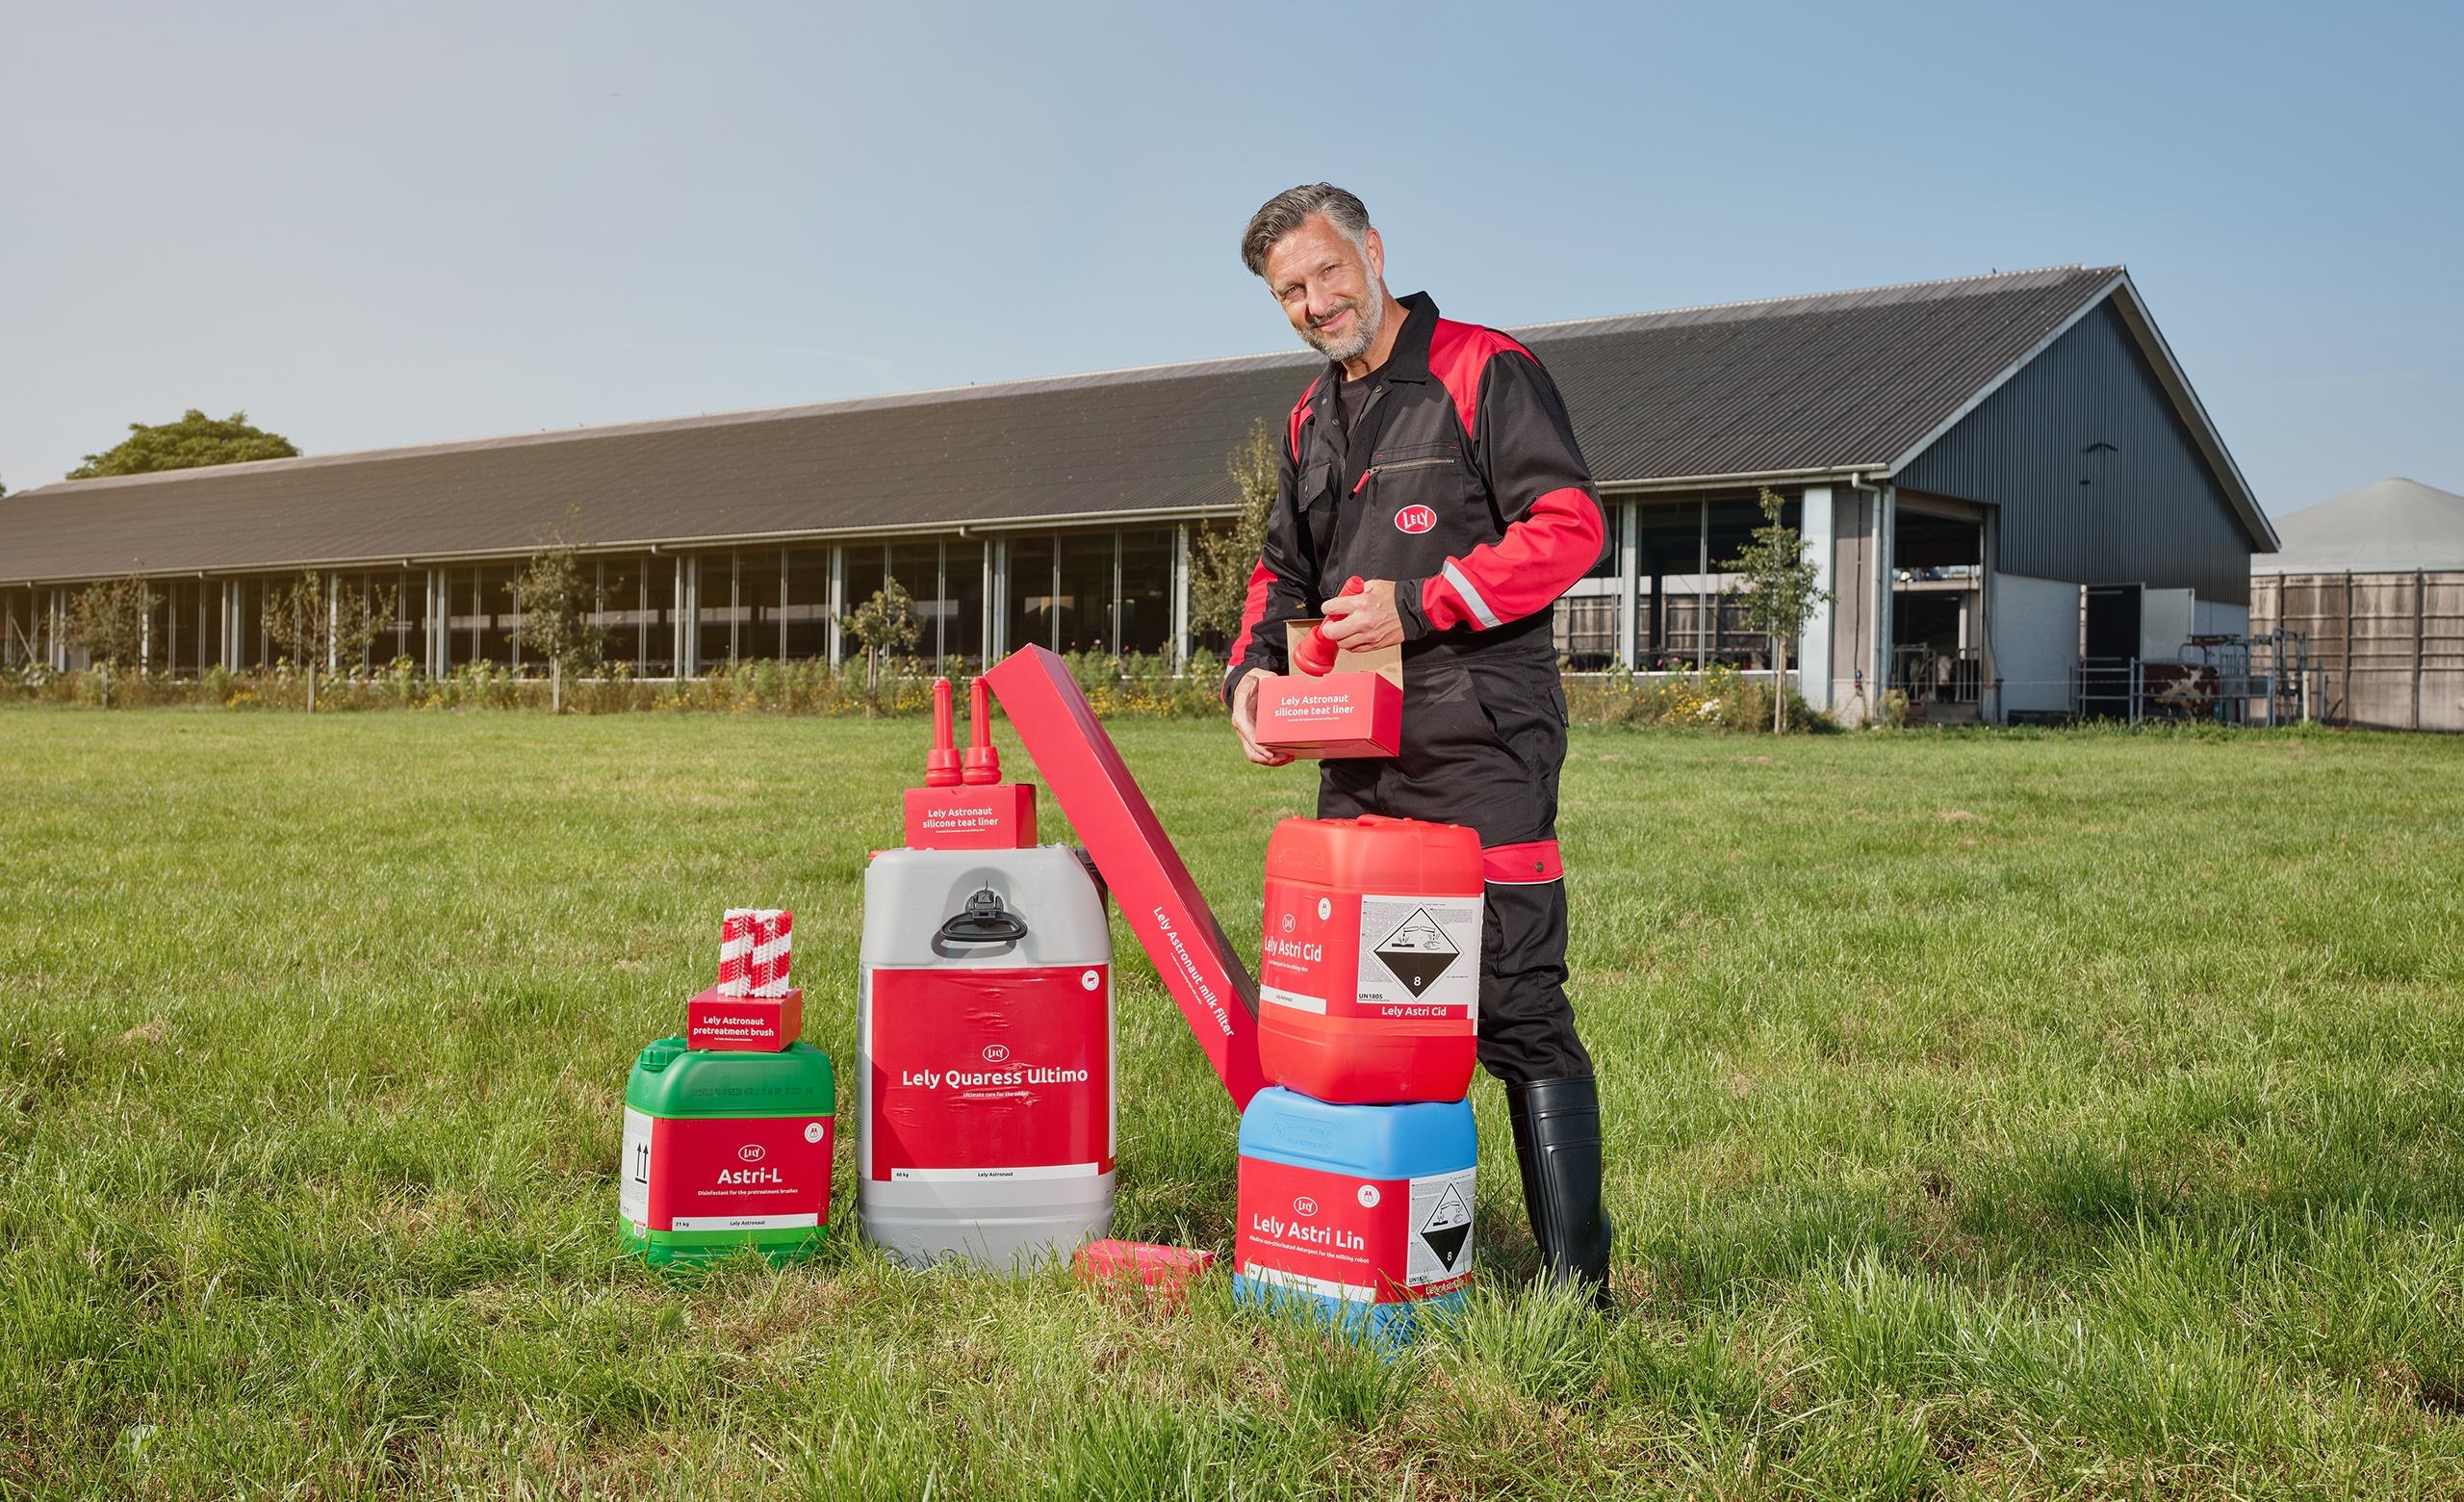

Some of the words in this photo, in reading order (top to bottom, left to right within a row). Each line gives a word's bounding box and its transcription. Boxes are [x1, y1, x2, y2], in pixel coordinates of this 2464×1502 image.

[1403, 511, 1429, 529] LELY
[1281, 696, 1300, 706] Lely
[1302, 694, 1348, 704] Astronaut
[1274, 708, 1309, 717] silicone
[1310, 707, 1331, 715] teat
[1333, 705, 1355, 714] liner
[928, 808, 946, 819] Lely
[948, 807, 993, 816] Astronaut
[923, 819, 956, 829] silicone
[957, 818, 976, 827] teat
[978, 817, 999, 826] liner
[1264, 935, 1278, 956] Lely
[1278, 939, 1301, 958] Astri
[1303, 944, 1322, 962] Cid
[1154, 906, 1171, 930] Lely
[1167, 931, 1204, 984] Astronaut
[1199, 980, 1218, 1010] milk
[1214, 1008, 1234, 1036] filter
[1413, 976, 1421, 986] 8
[1382, 1006, 1403, 1017] Lely
[1405, 1007, 1429, 1016] Astri
[1431, 1007, 1447, 1016] Cid
[704, 1016, 720, 1026] Lely
[722, 1017, 764, 1025] Astronaut
[693, 1027, 749, 1036] pretreatment
[751, 1028, 774, 1036] brush
[903, 1070, 941, 1089] Lely
[946, 1069, 1022, 1088] Quaress
[1028, 1066, 1088, 1084] Ultimo
[718, 1167, 782, 1184] Astri-L
[1253, 1213, 1285, 1237] Lely
[1288, 1221, 1331, 1245] Astri
[1336, 1230, 1365, 1251] Lin
[1296, 1245, 1318, 1256] detergent
[1335, 1254, 1354, 1262] milking
[1447, 1251, 1452, 1261] 8
